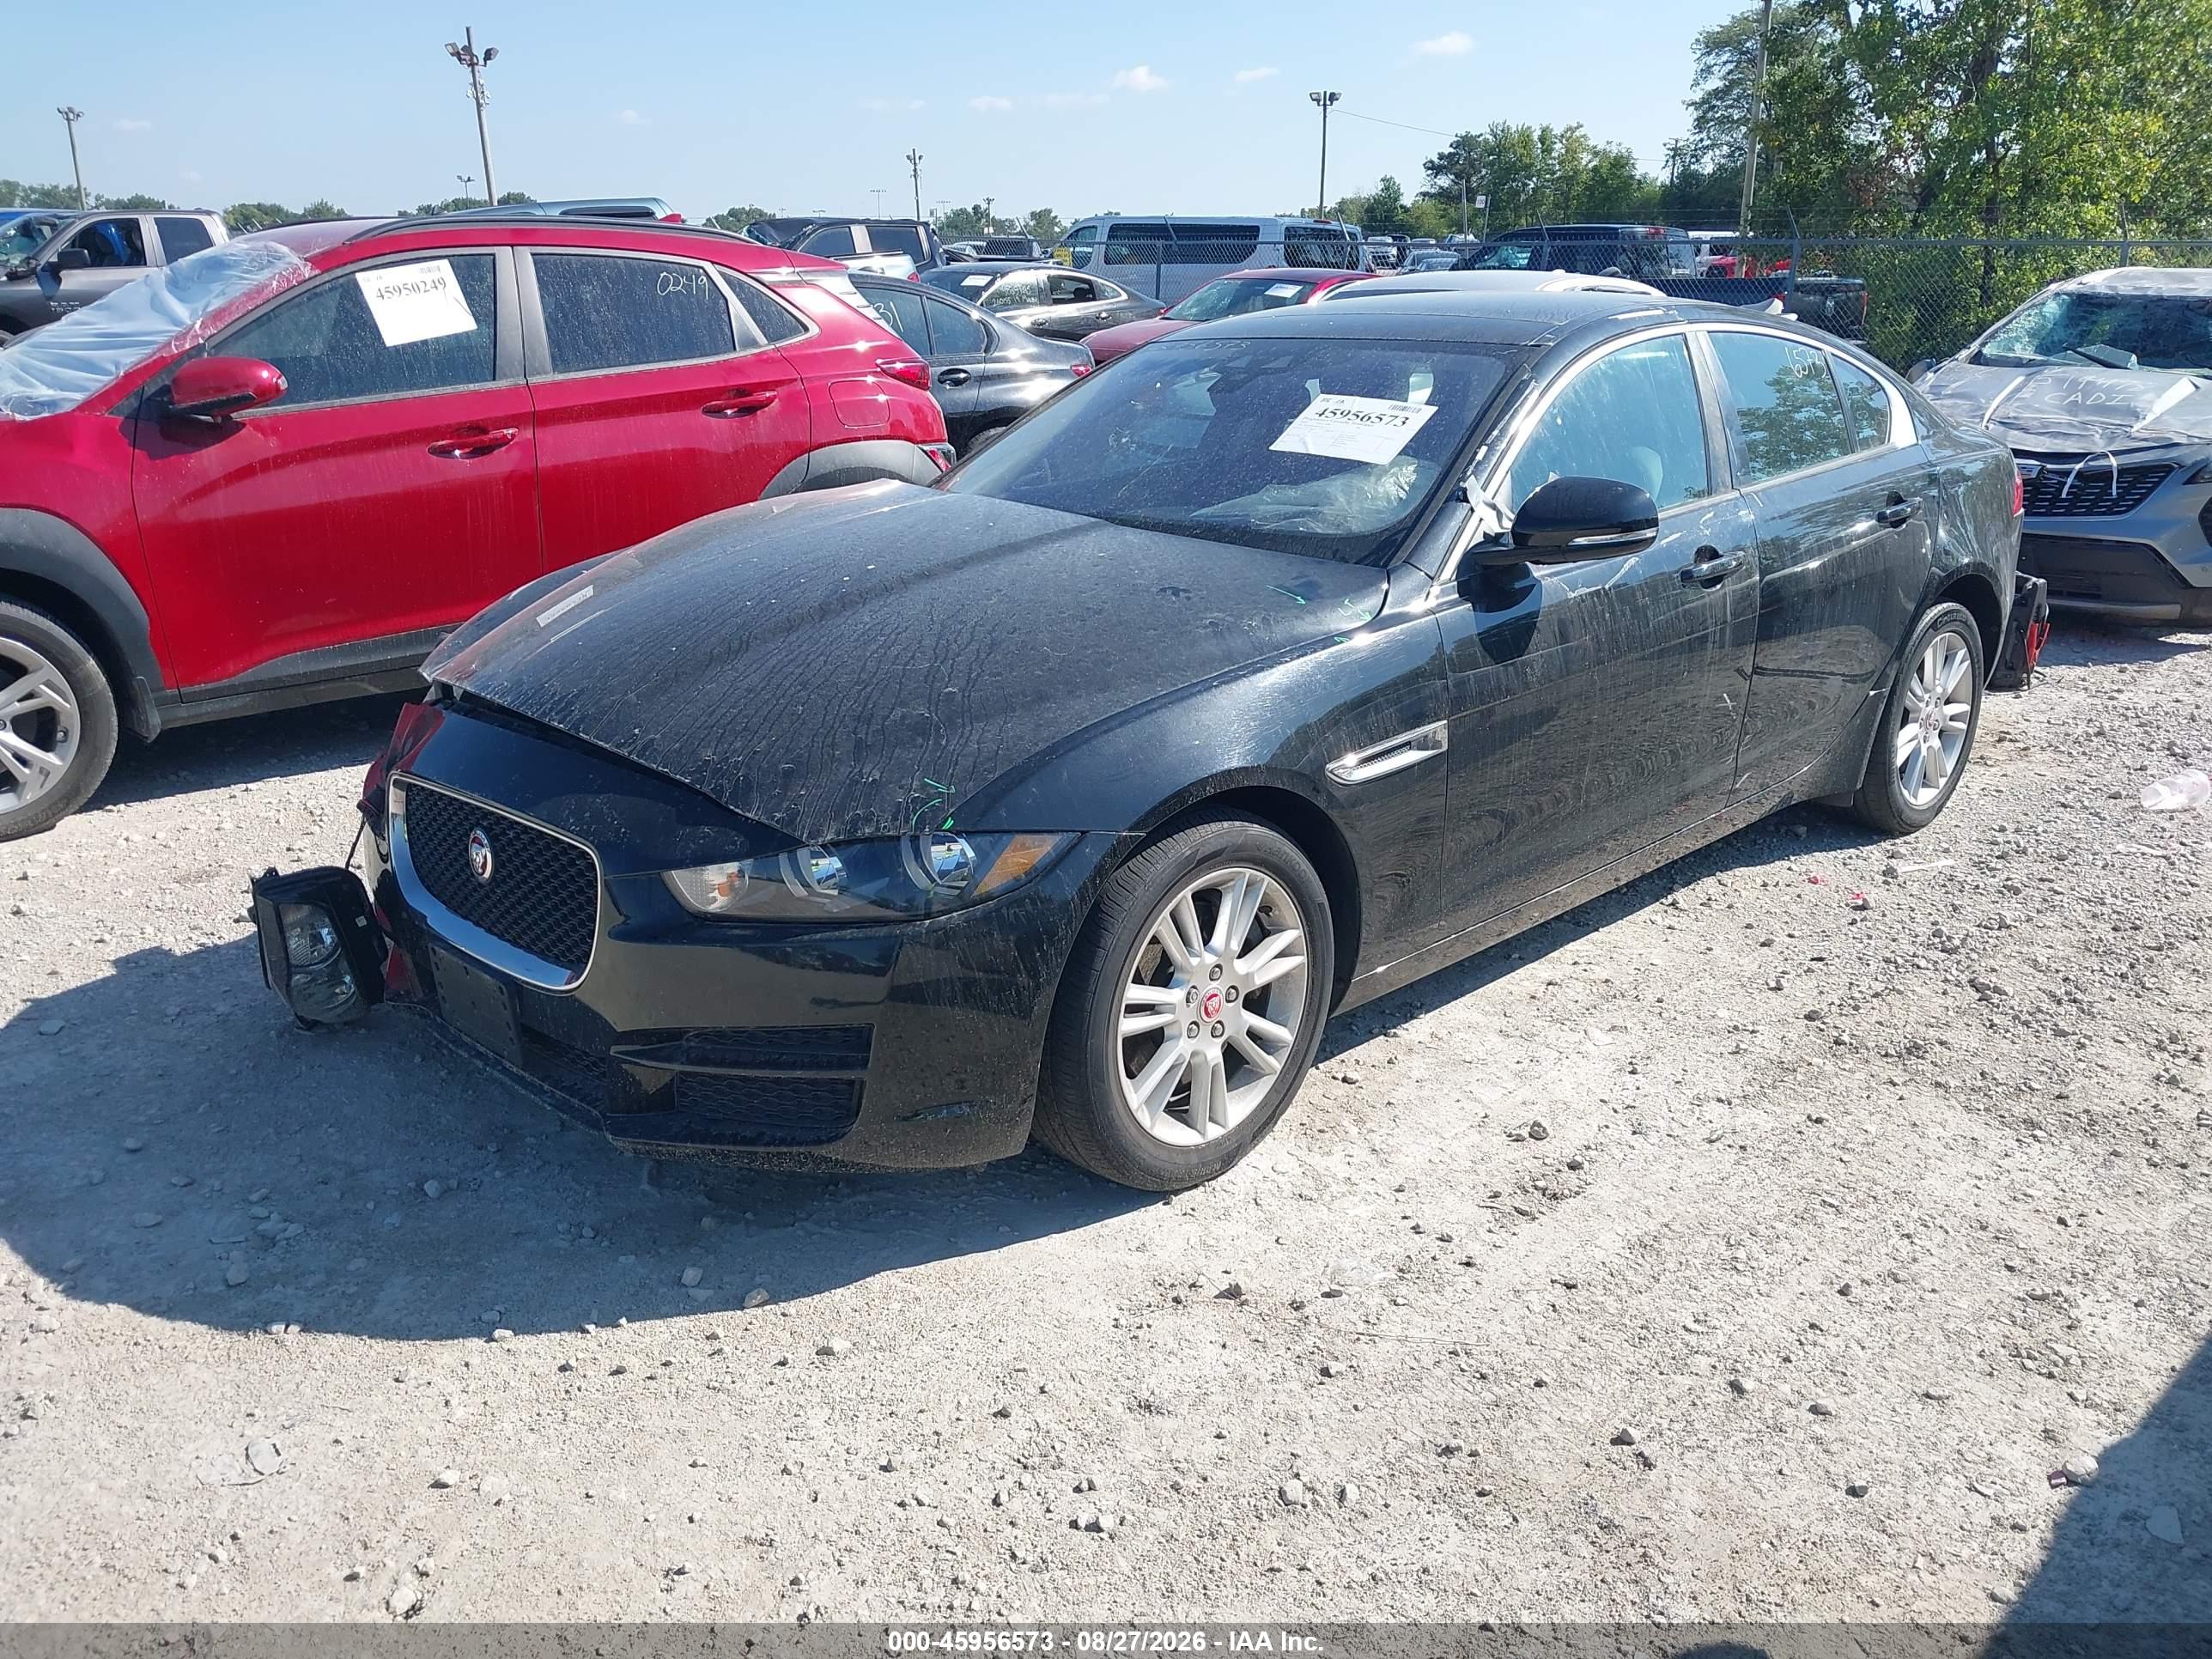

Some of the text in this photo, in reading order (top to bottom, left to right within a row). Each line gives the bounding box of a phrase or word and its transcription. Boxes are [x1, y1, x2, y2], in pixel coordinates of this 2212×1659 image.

[376, 276, 447, 301] 45950249
[657, 271, 708, 301] 0249
[1785, 346, 1827, 378] 6573
[2044, 392, 2134, 405] CADI
[1316, 407, 1409, 427] 45956573
